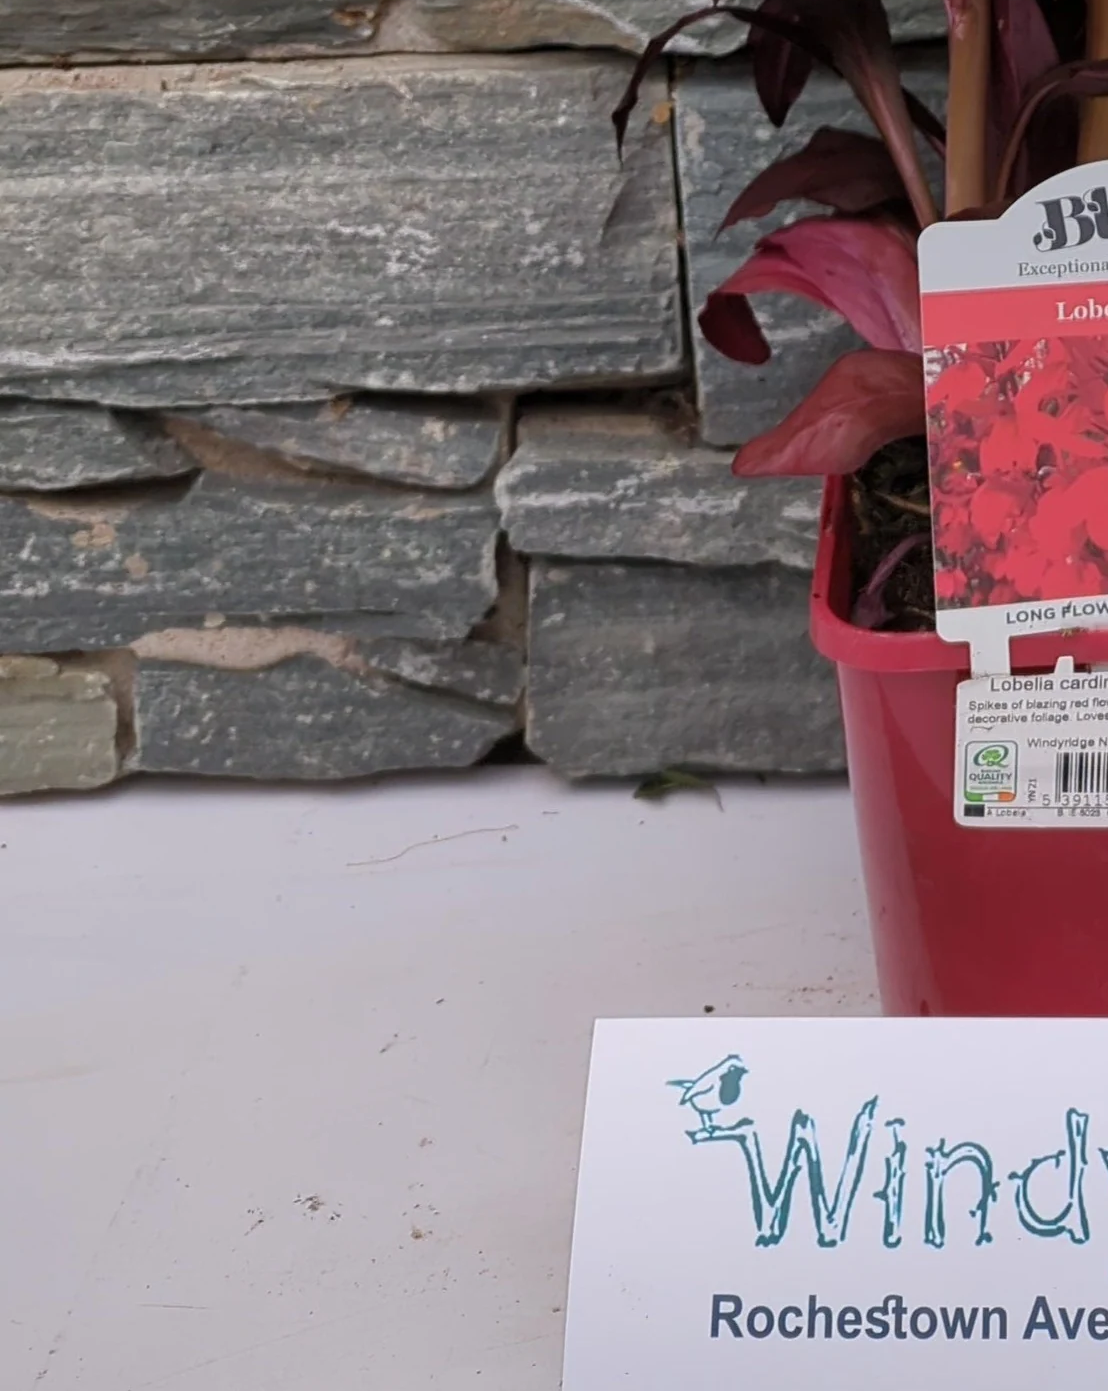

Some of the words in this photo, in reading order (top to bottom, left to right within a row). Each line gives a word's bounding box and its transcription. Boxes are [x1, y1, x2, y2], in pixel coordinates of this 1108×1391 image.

[1006, 607, 1056, 624] LONG
[990, 677, 1054, 692] Lobelia
[968, 700, 1007, 713] Spikes
[1011, 700, 1023, 709] of
[1026, 699, 1066, 712] blazing
[1070, 698, 1089, 708] red
[968, 713, 1027, 724] decorative
[1027, 738, 1095, 749] Windyridge
[969, 773, 1012, 781] QUALITY
[709, 1294, 1008, 1340] Rochestown
